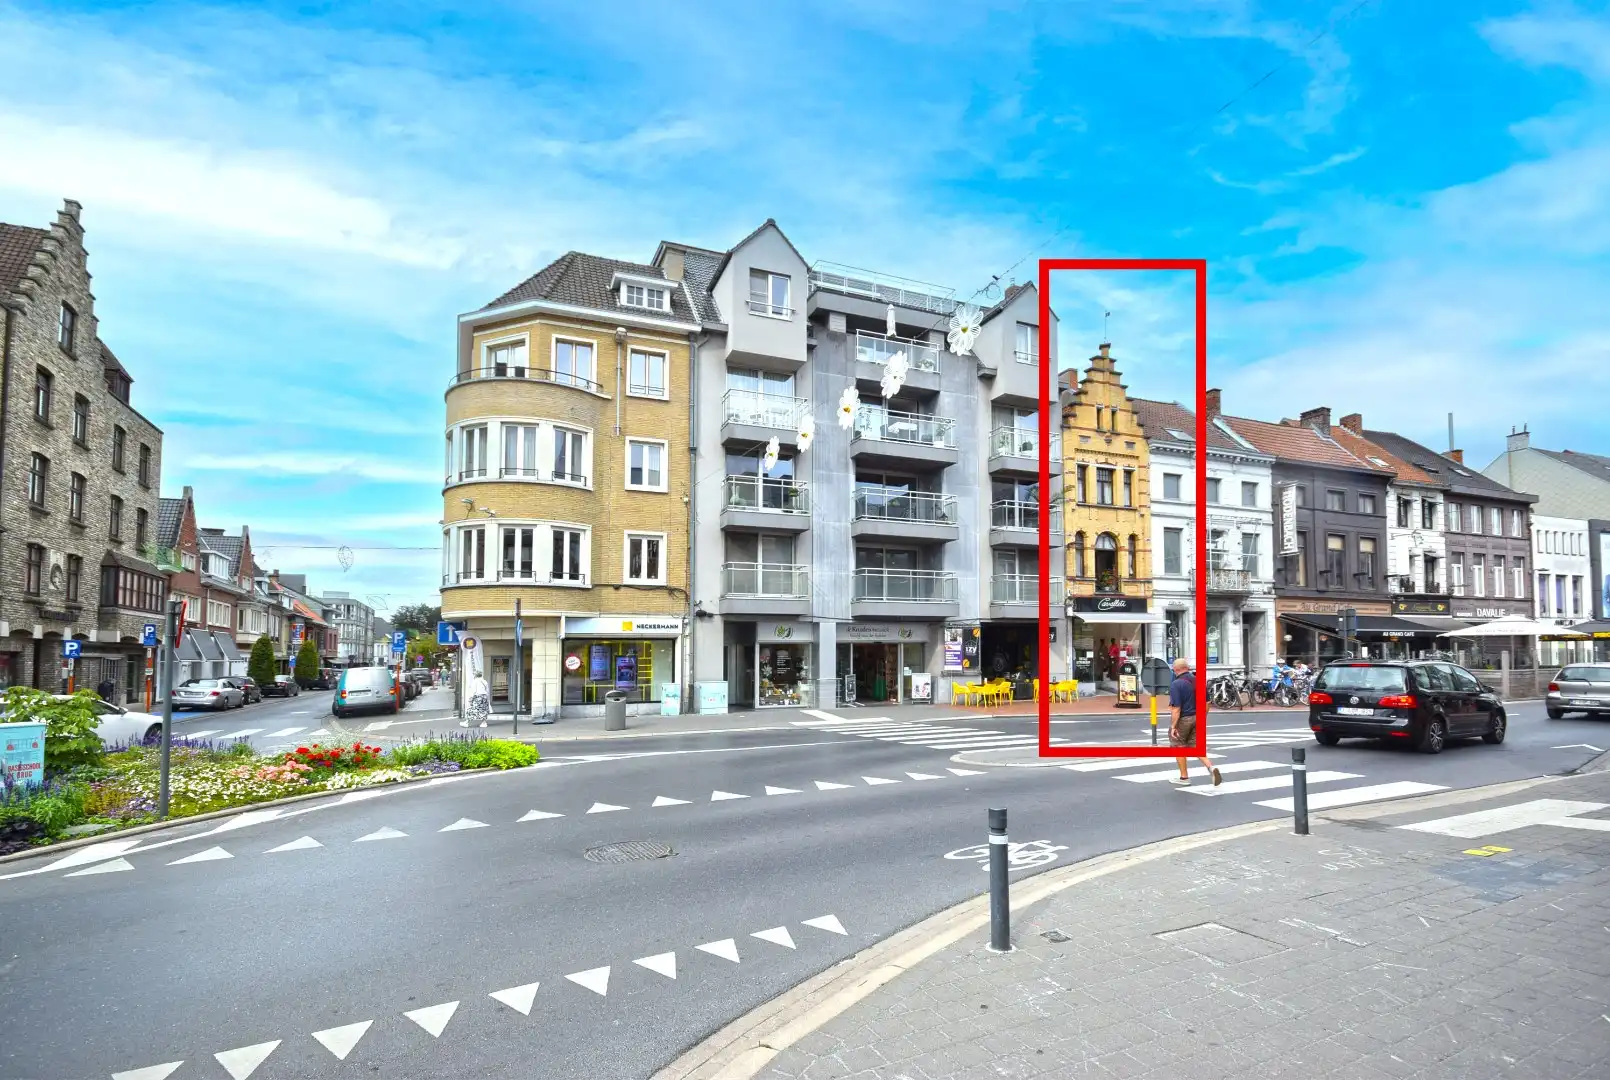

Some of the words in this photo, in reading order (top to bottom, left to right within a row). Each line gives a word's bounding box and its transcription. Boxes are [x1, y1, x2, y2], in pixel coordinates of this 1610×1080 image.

[1283, 491, 1294, 549] RODENBACH
[145, 626, 154, 636] P
[394, 632, 404, 644] P
[65, 642, 78, 655] P
